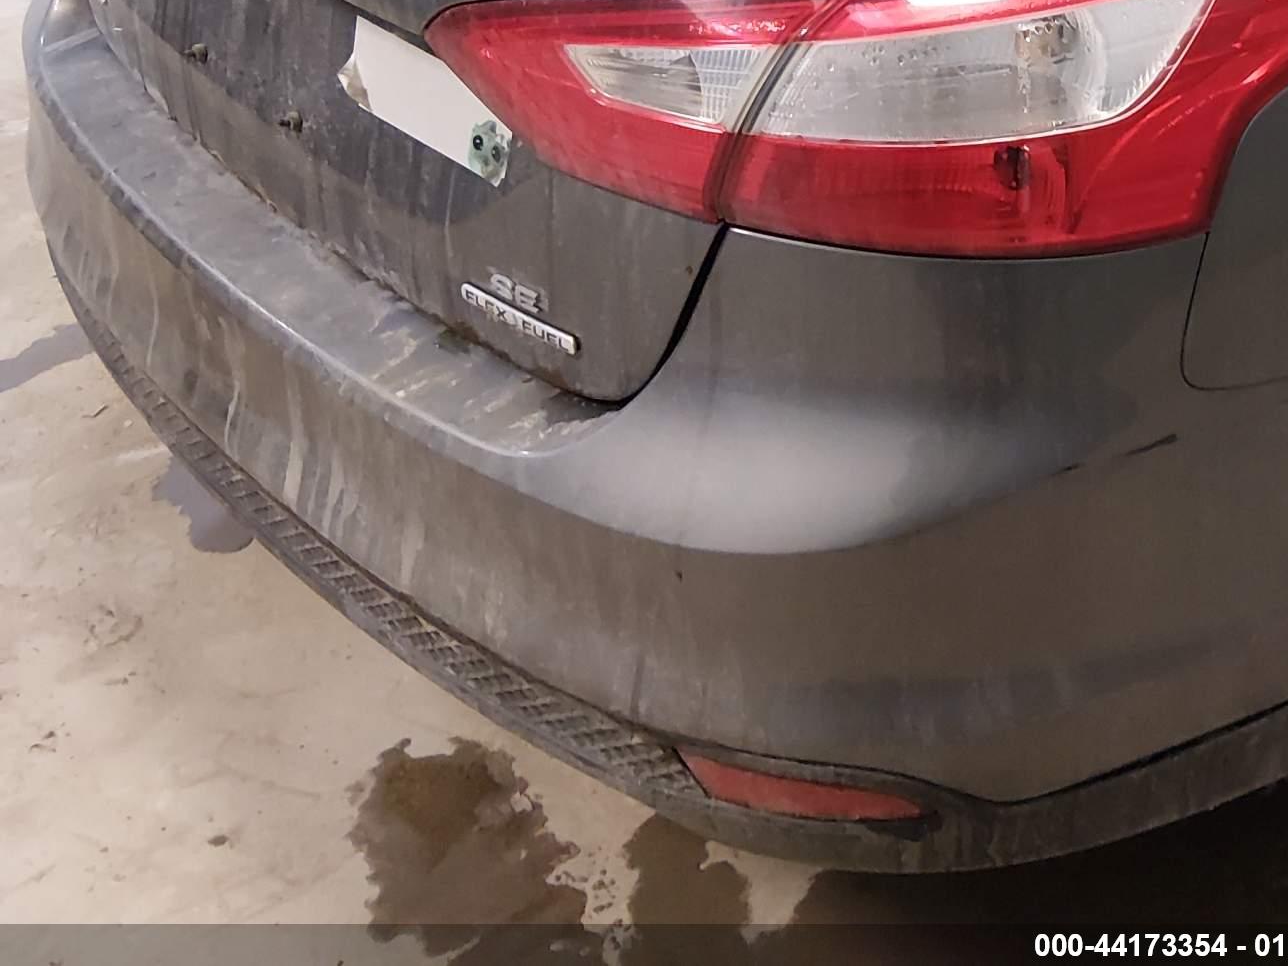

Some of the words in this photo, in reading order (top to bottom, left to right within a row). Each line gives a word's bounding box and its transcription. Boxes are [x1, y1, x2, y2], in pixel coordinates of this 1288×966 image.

[490, 273, 540, 314] SE
[465, 289, 507, 322] FLEX
[521, 319, 569, 352] FUEL
